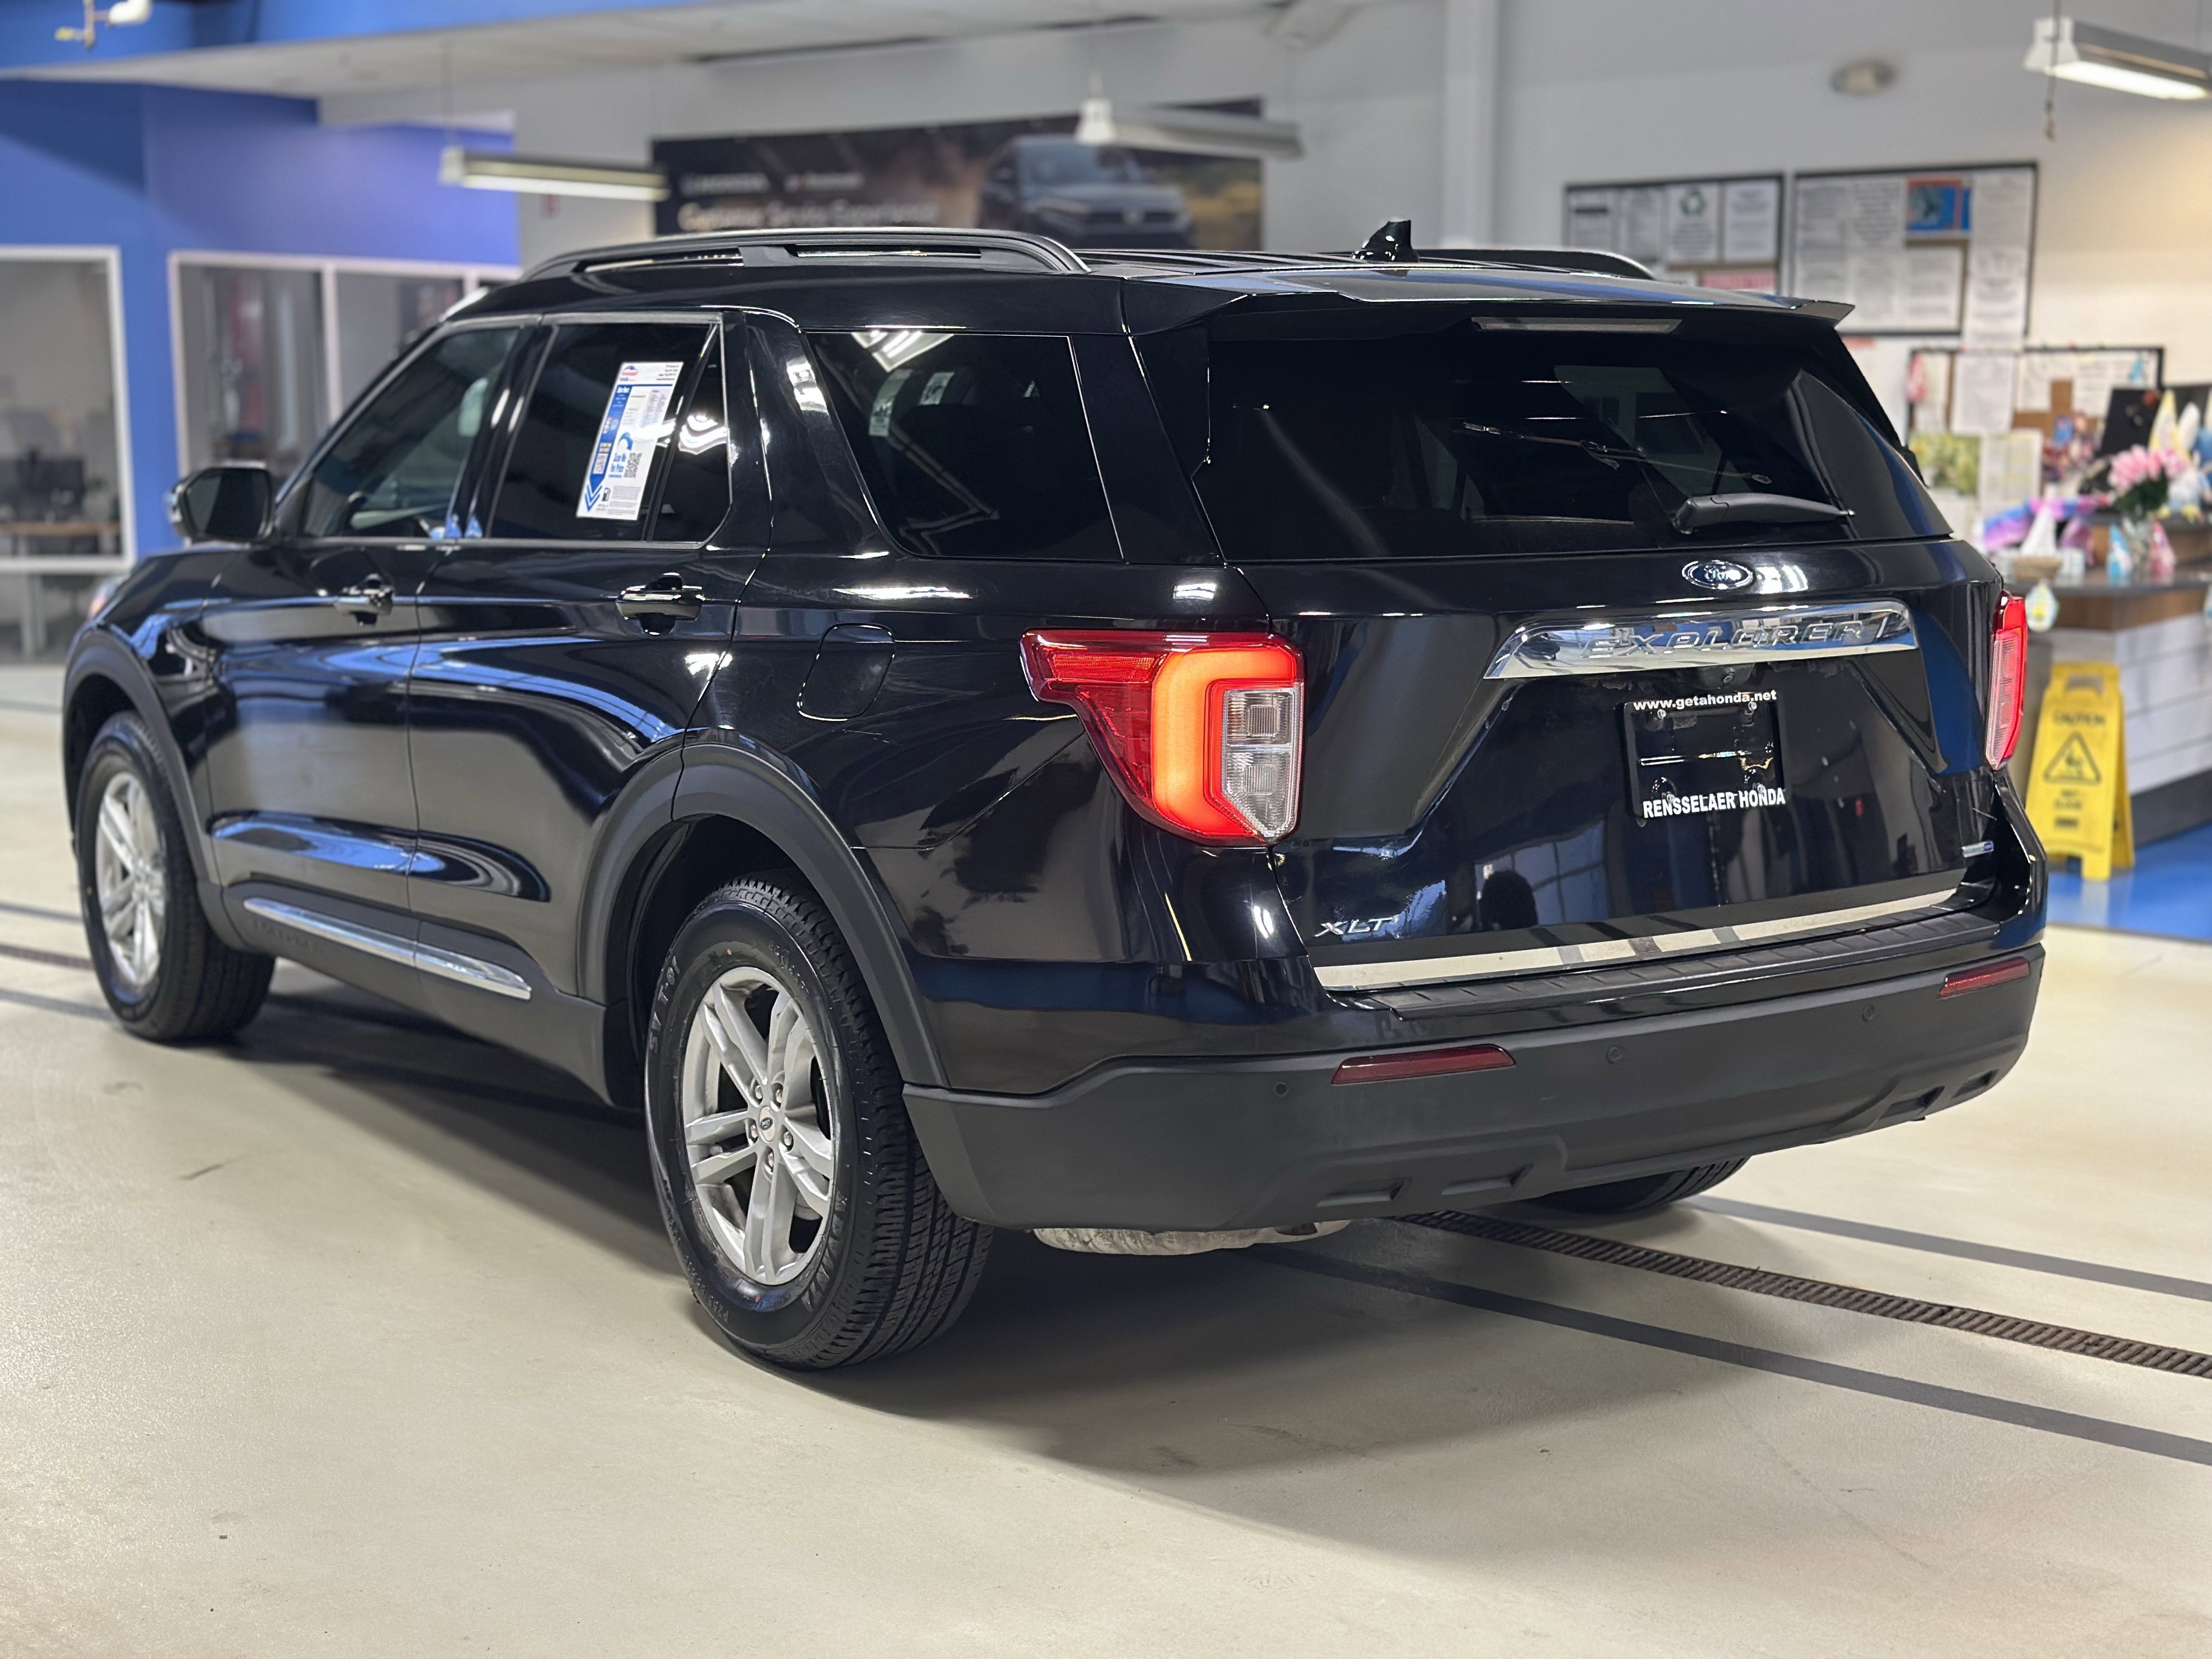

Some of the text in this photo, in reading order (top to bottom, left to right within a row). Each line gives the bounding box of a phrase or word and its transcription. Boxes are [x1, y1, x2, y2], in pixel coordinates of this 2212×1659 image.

[1704, 565, 1741, 582] For
[1580, 620, 1865, 658] EXPLORER
[1633, 690, 1777, 710] www.getahonda.net
[1643, 787, 1786, 818] RENSSELAER HONDA
[1314, 917, 1393, 937] XLT
